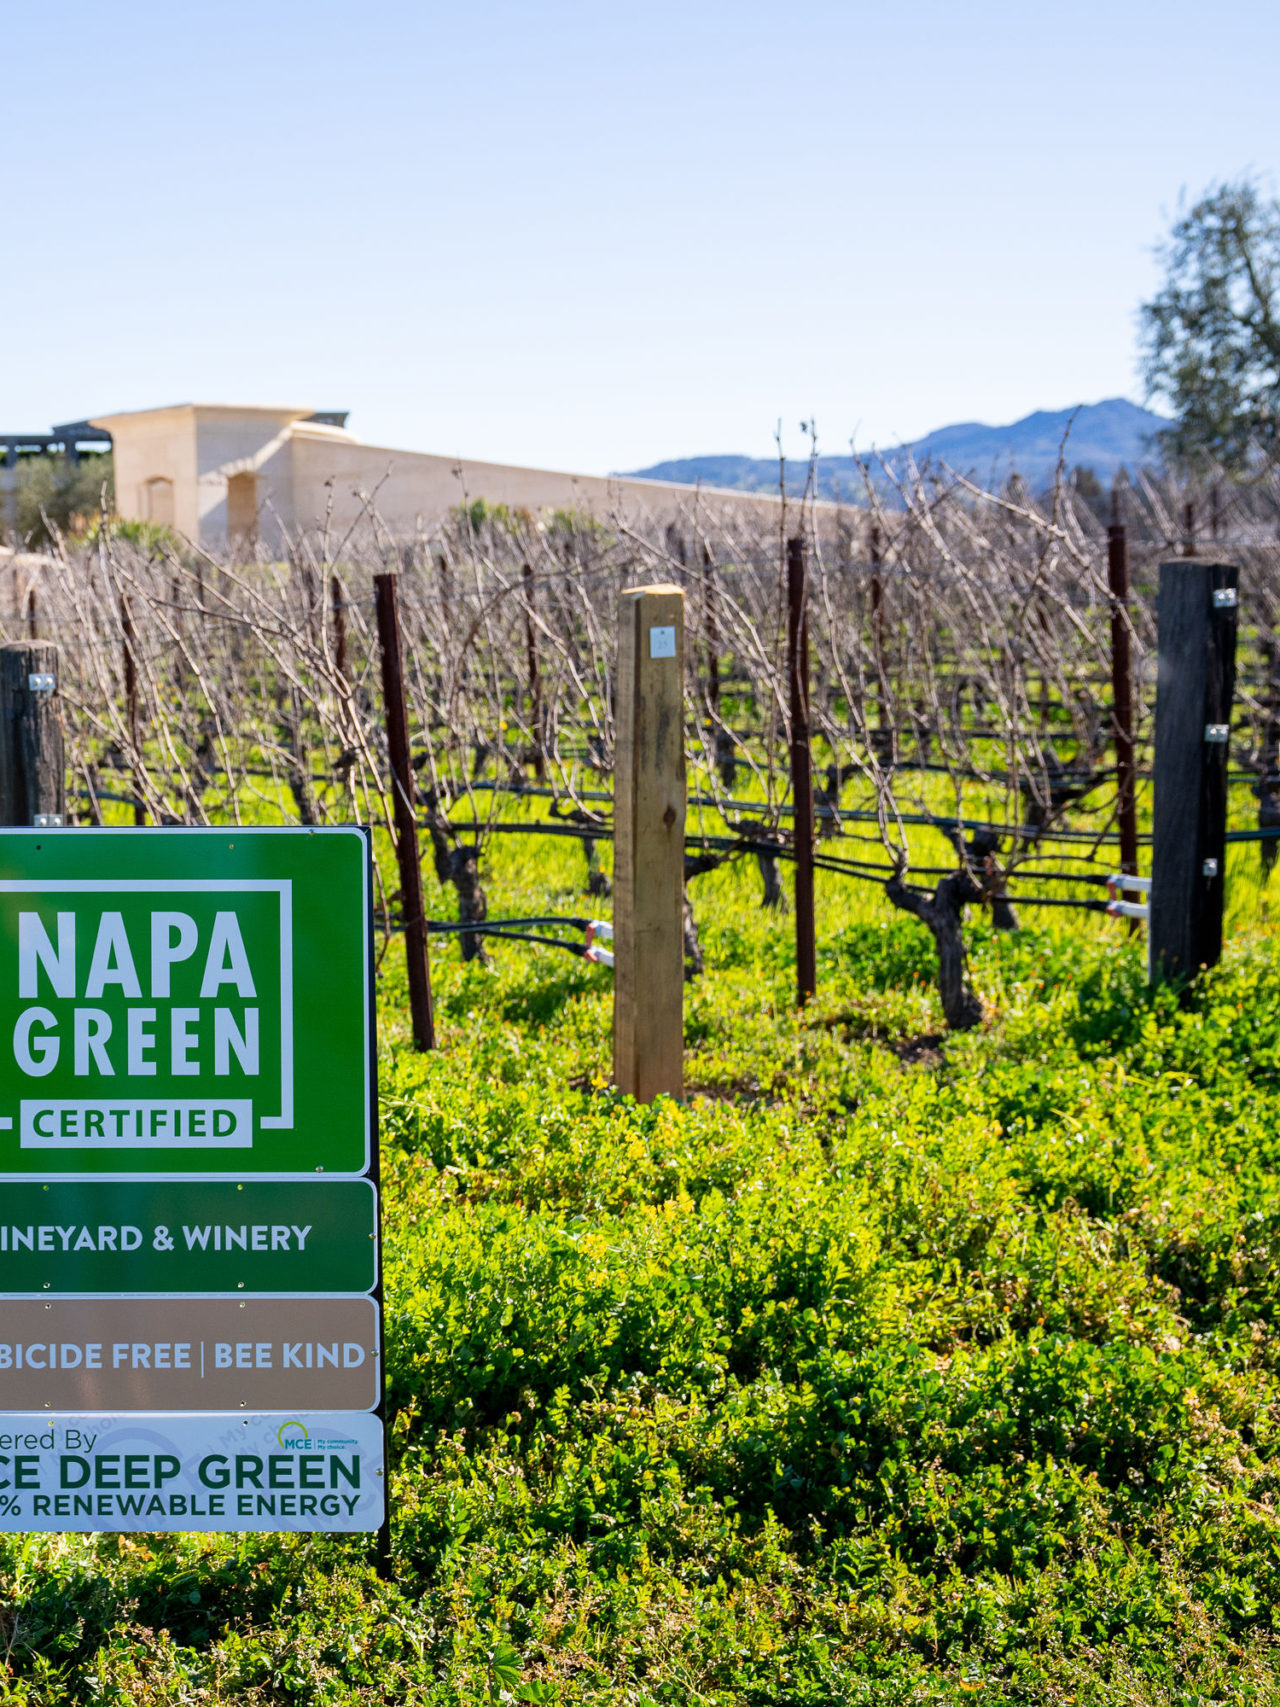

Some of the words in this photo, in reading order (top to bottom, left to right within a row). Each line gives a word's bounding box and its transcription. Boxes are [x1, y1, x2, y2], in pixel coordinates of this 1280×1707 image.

[18, 911, 258, 998] NAPA
[13, 1007, 260, 1077] GREEN
[33, 1109, 237, 1138] CERTIFIED
[152, 1225, 175, 1252] &
[182, 1225, 313, 1252] WINERY
[112, 1343, 192, 1369] FREE
[214, 1342, 273, 1369] BEE
[282, 1342, 366, 1369] KIND
[65, 1429, 97, 1454] By
[284, 1438, 313, 1450] MCE
[59, 1454, 181, 1489] DEEP
[197, 1454, 361, 1490] GREEN
[33, 1494, 226, 1516] RENEWABLE
[237, 1494, 361, 1517] ENERGY
